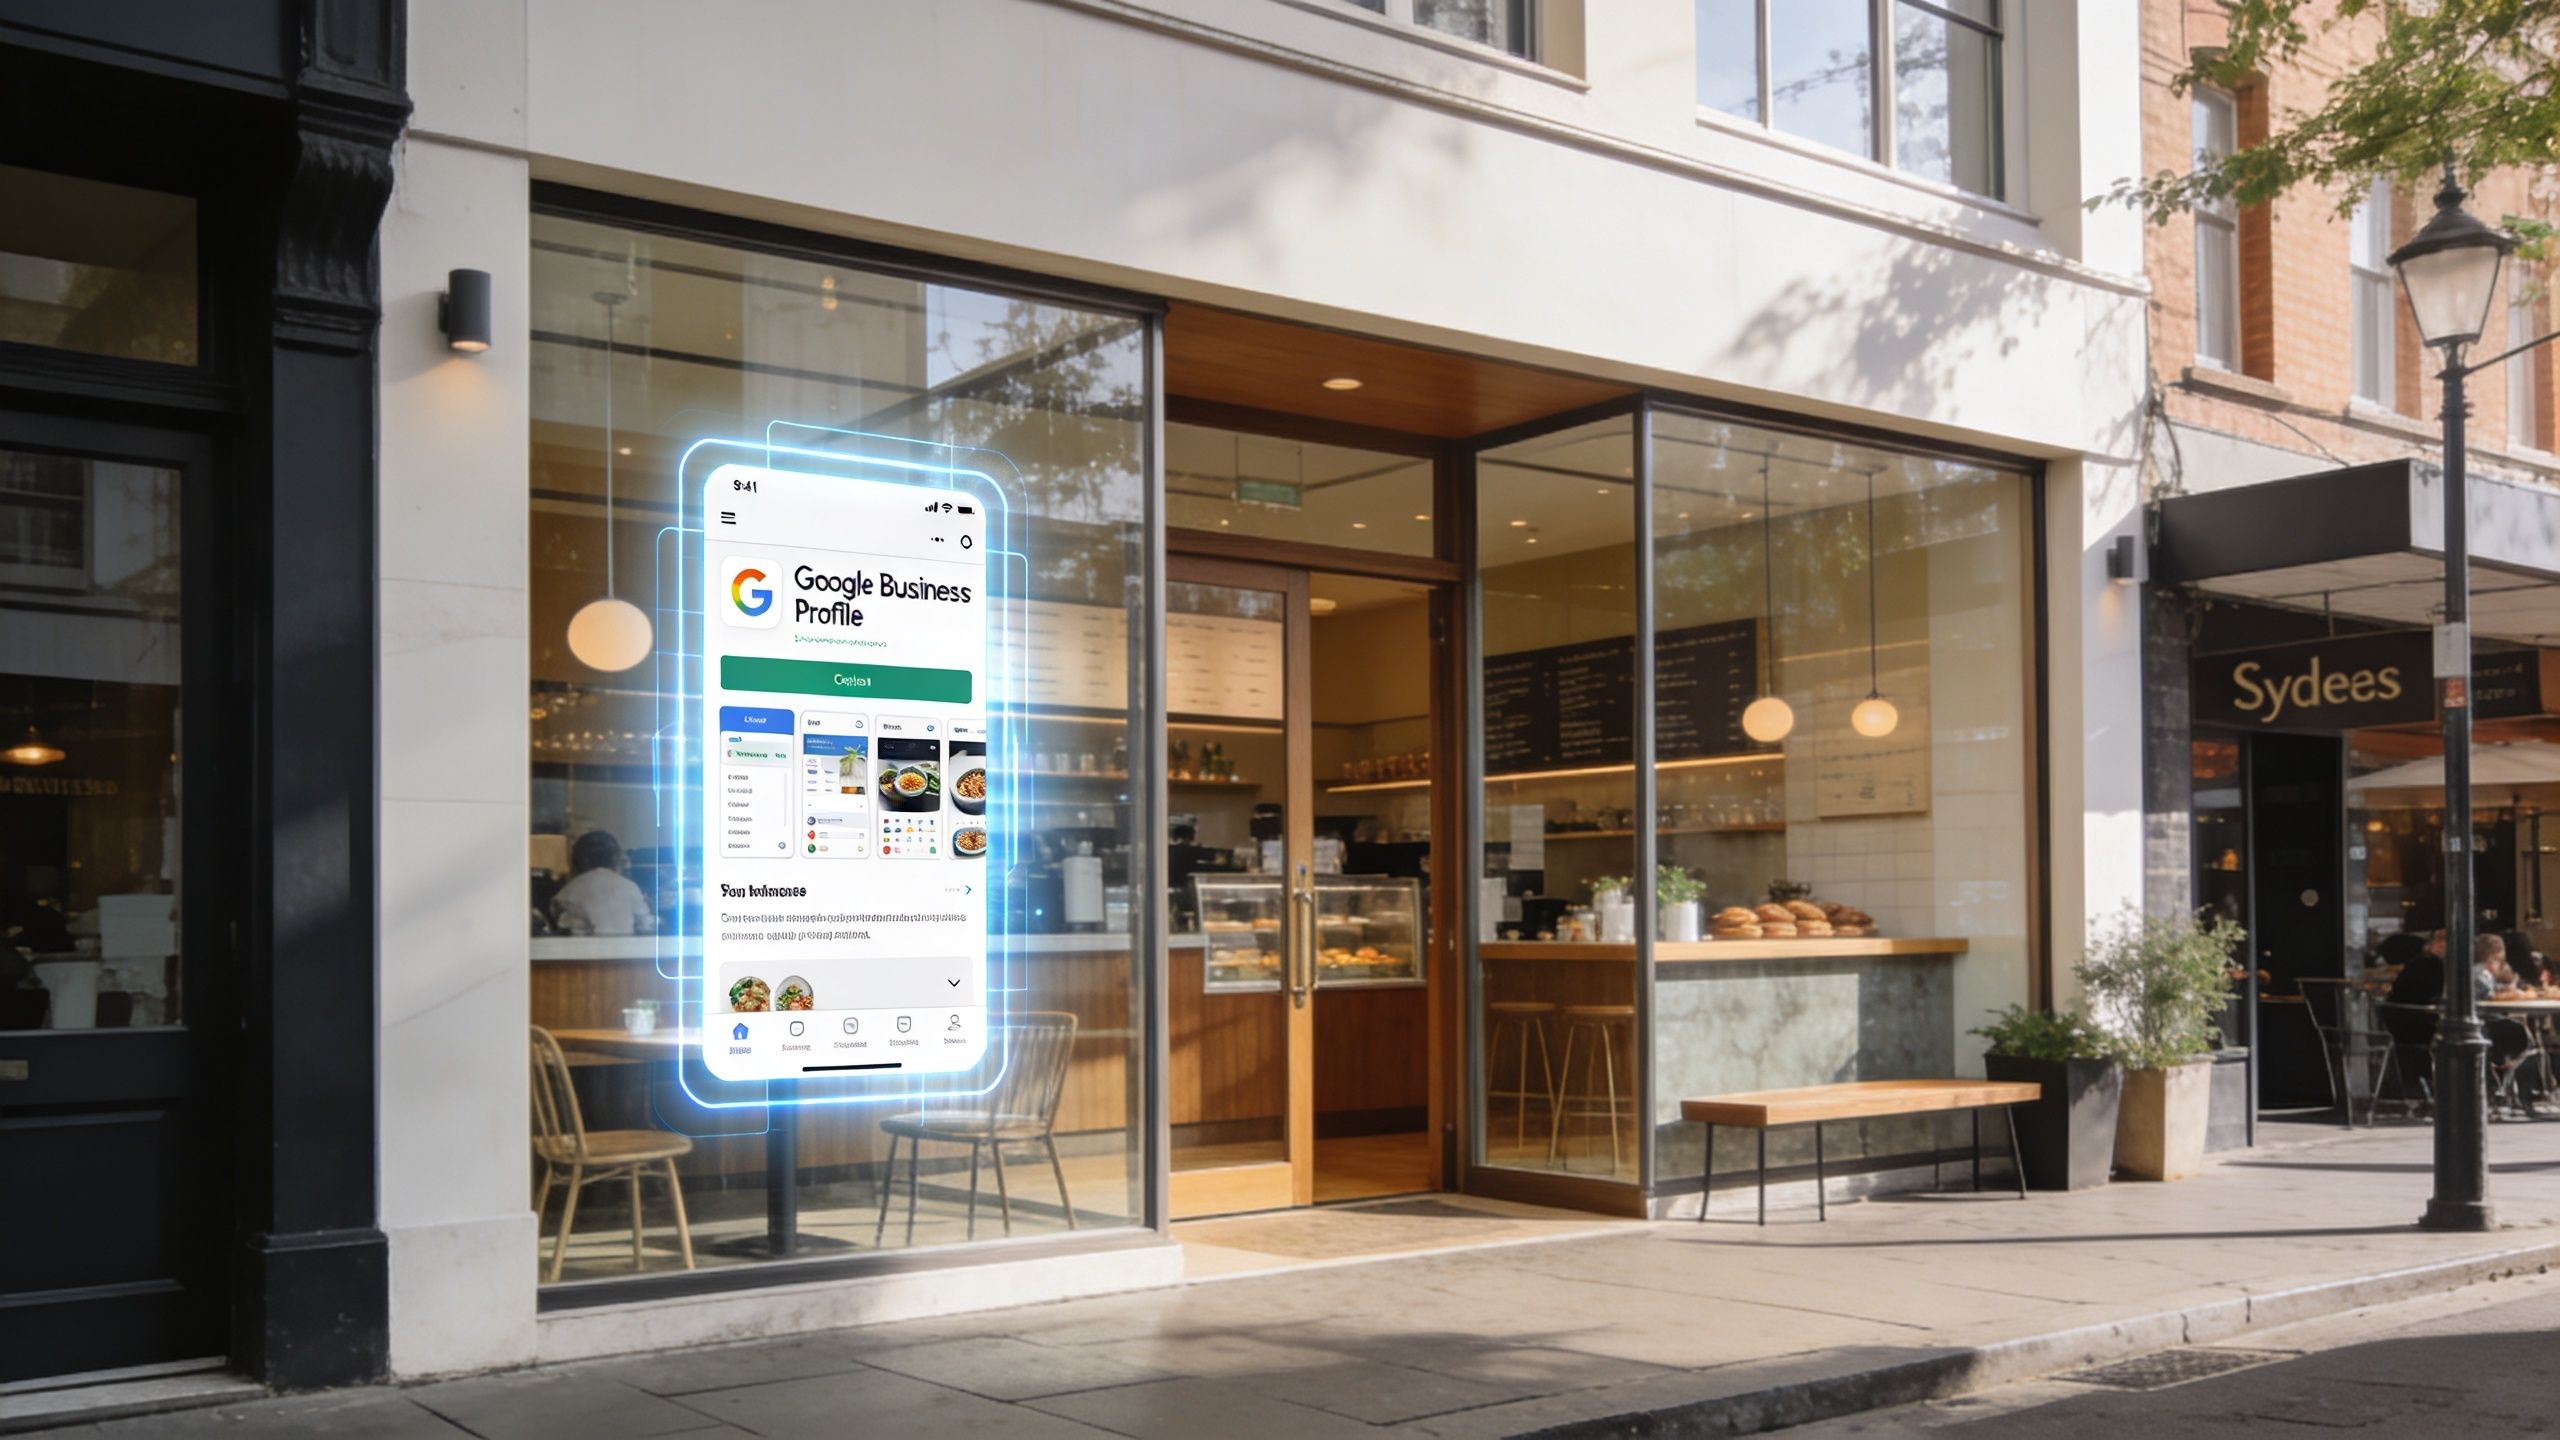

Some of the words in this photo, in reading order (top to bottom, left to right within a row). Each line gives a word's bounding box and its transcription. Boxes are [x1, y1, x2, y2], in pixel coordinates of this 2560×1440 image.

[731, 568, 773, 617] G
[794, 565, 873, 601] Google
[880, 572, 972, 603] Business
[795, 599, 864, 627] Profile
[2233, 656, 2402, 723] Sydees
